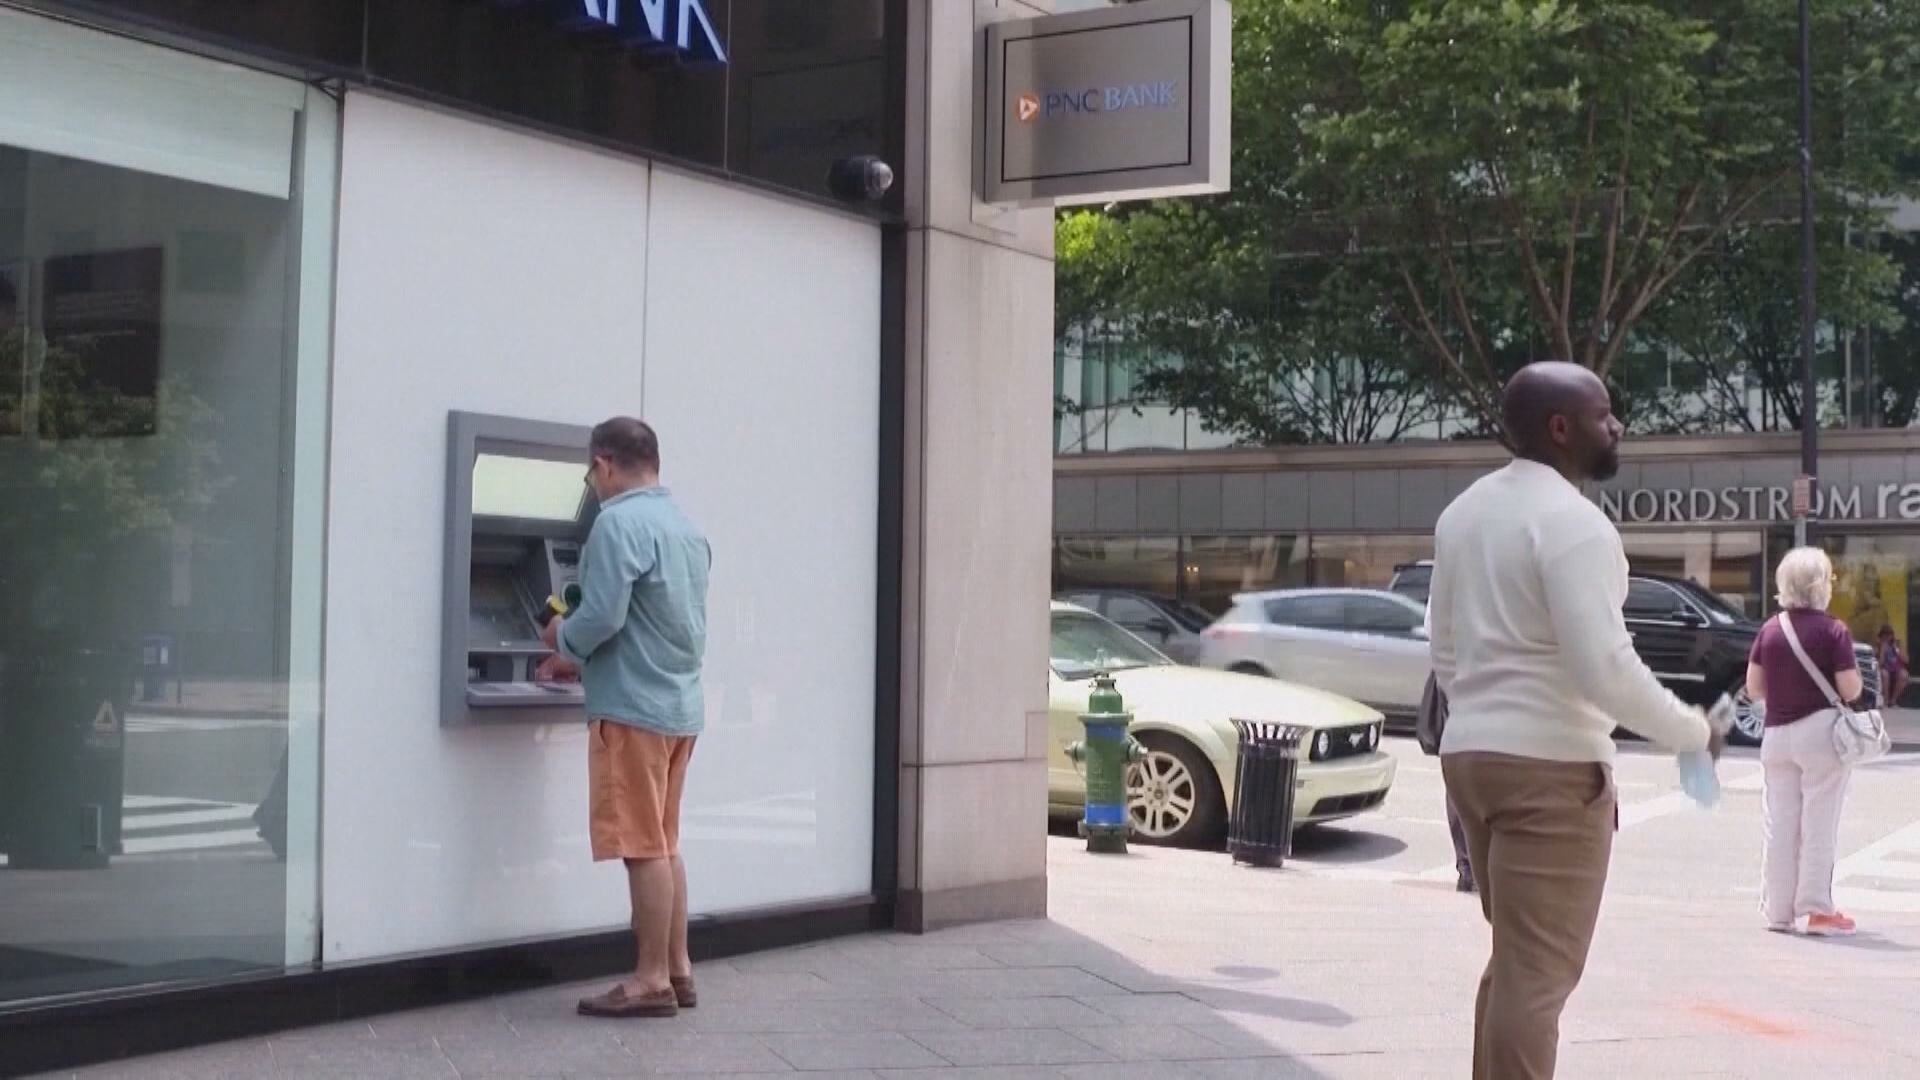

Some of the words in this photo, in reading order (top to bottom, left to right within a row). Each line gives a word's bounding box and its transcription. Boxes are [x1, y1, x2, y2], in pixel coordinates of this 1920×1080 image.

[1046, 88, 1099, 117] PNC
[1103, 80, 1177, 111] BANK
[1600, 485, 1861, 521] NORDSTRM
